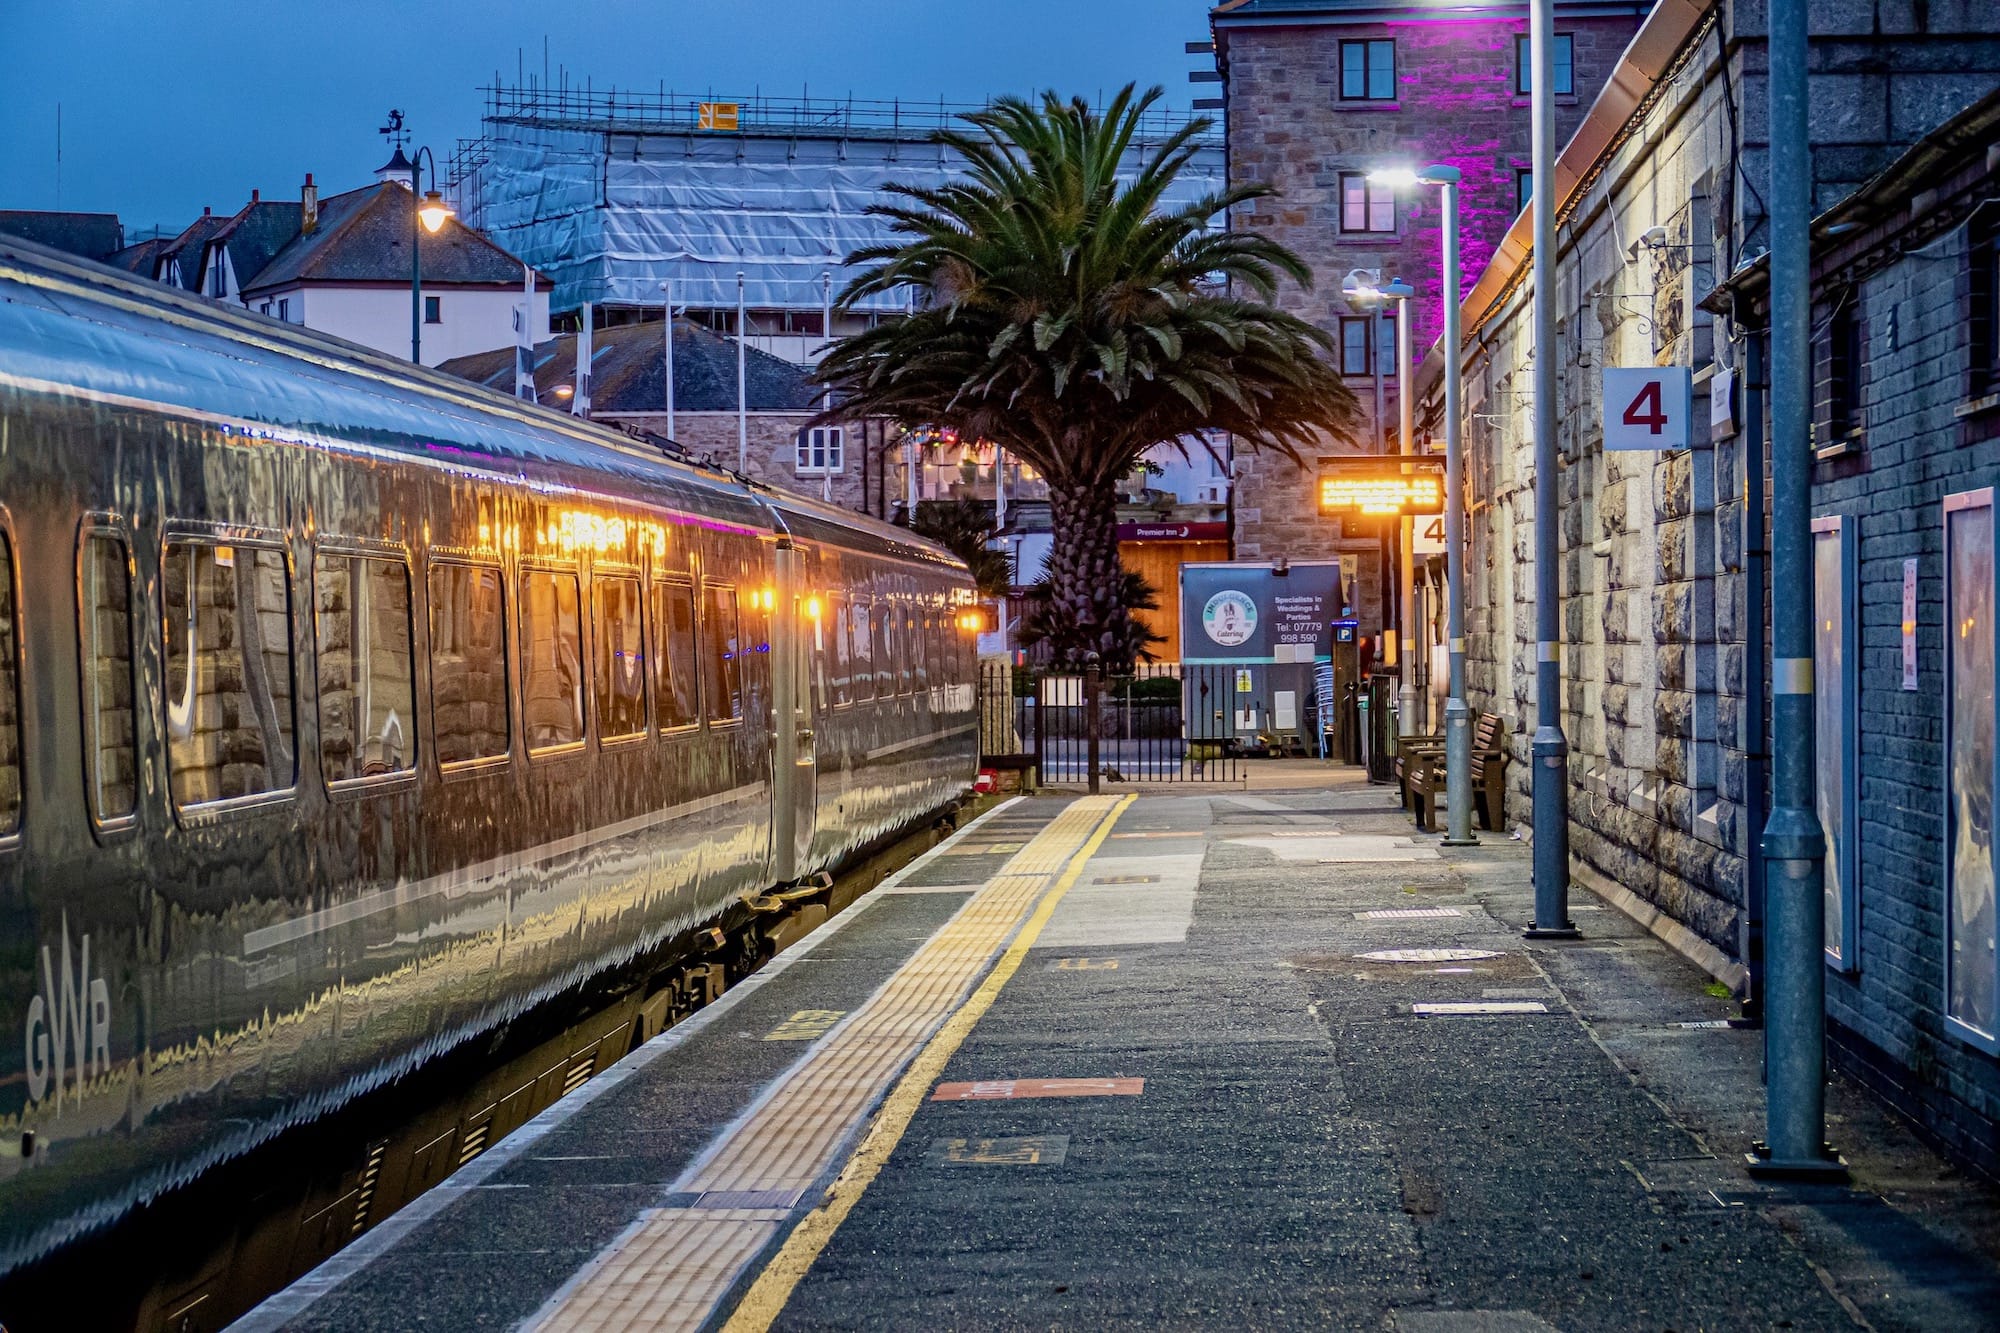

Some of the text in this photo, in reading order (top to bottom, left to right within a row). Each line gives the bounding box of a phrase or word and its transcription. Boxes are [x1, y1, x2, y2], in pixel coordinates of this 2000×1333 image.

[1623, 381, 1667, 434] 4
[1136, 528, 1178, 536] Premier Inn
[1424, 518, 1446, 543] 4
[1275, 596, 1313, 604] Specialists
[1277, 605, 1313, 613] Weddings
[1275, 622, 1322, 632] Tel: 07779
[1217, 629, 1244, 638] Catering
[1341, 629, 1350, 639] P
[1281, 634, 1317, 643] 998 590
[26, 906, 110, 1120] GWR
